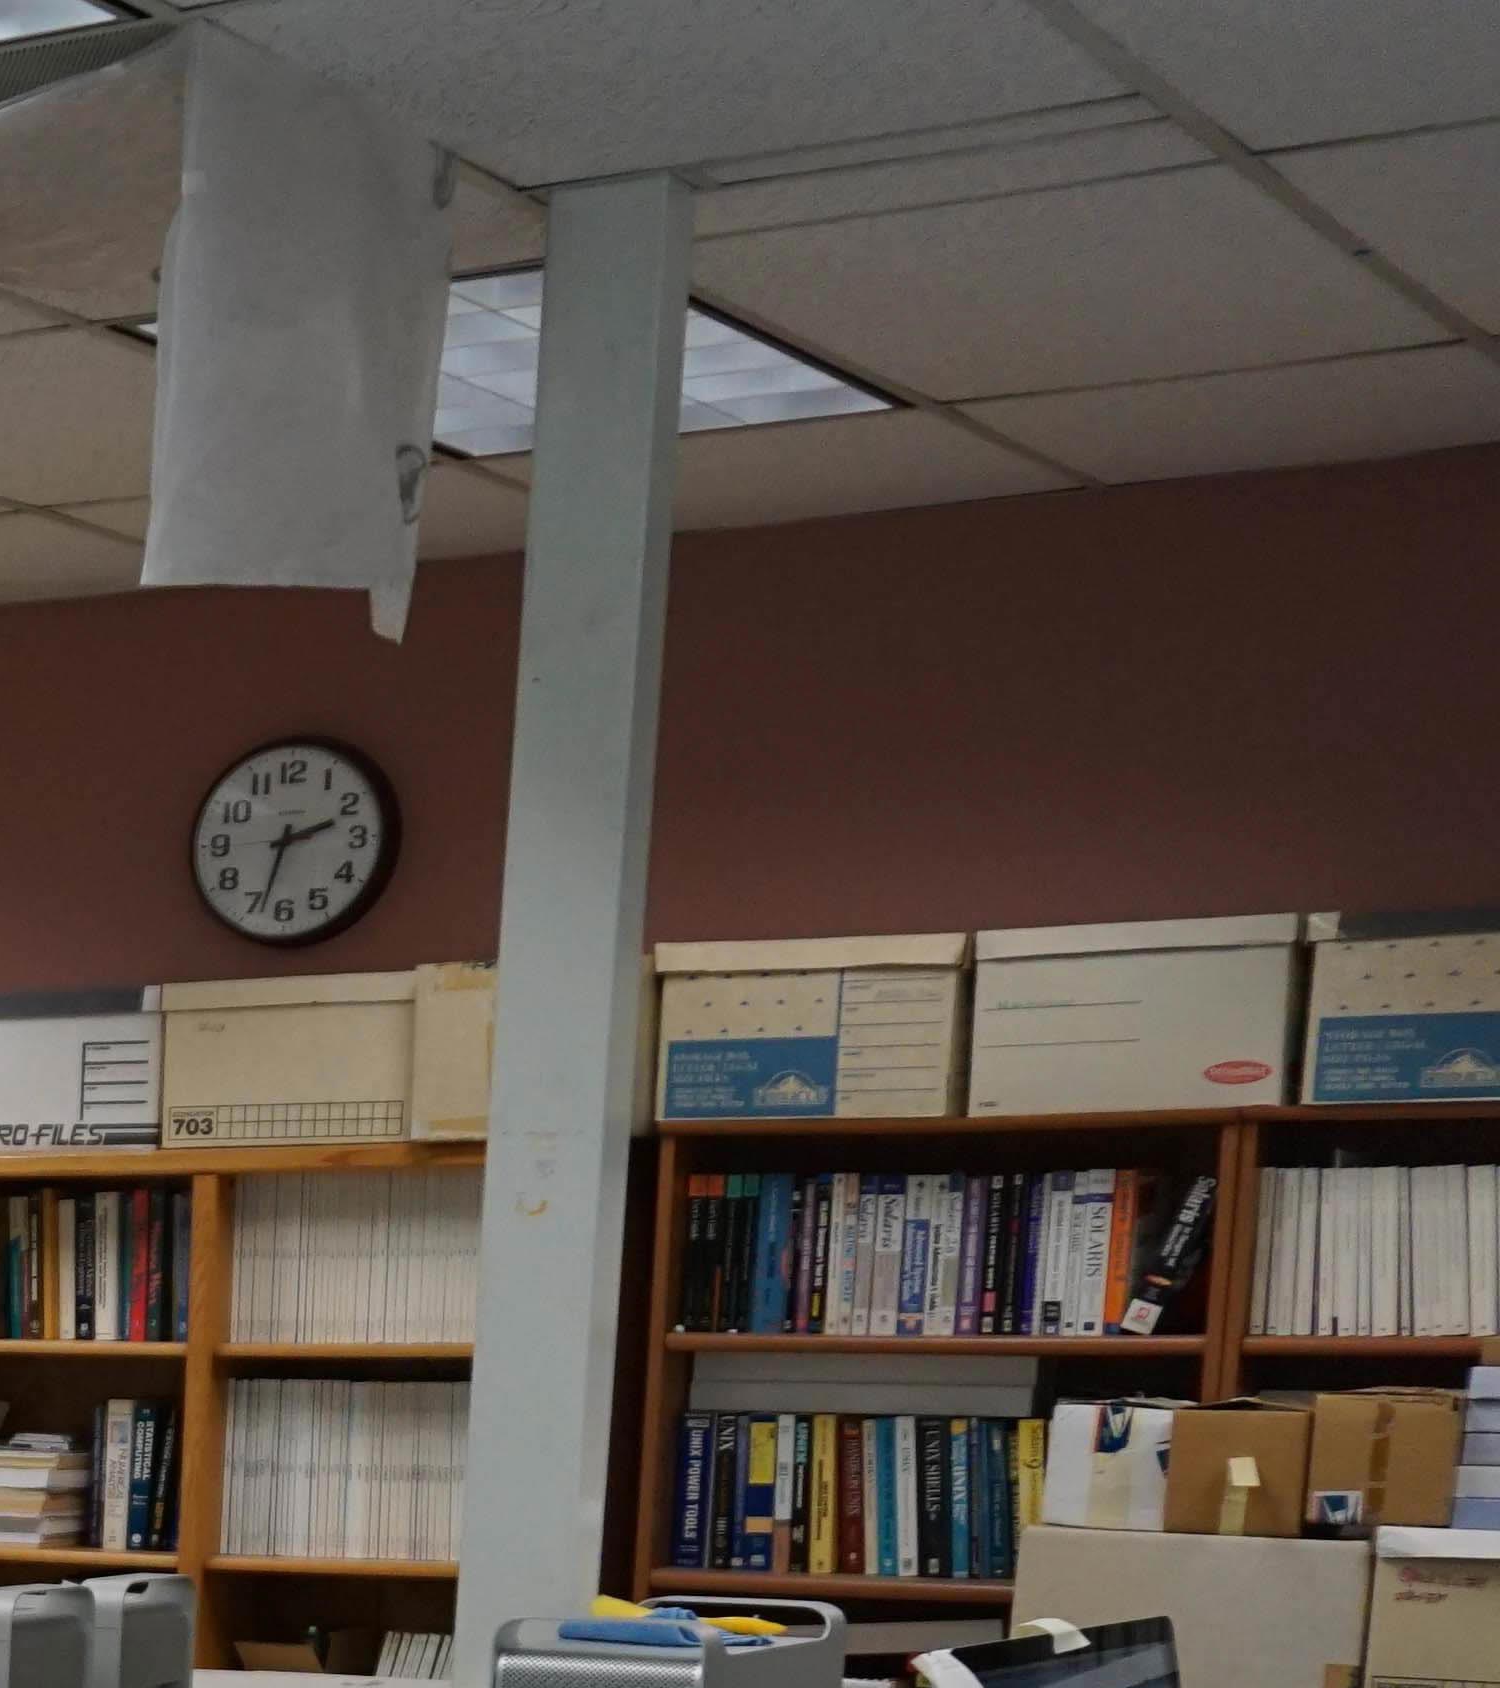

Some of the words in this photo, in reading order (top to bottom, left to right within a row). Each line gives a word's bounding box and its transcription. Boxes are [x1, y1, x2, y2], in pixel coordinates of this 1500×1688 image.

[252, 772, 271, 796] 11
[280, 759, 307, 785] 12
[323, 768, 332, 791] 1
[223, 800, 252, 824] 10
[340, 793, 360, 817] 2
[210, 834, 231, 858] 9
[348, 825, 368, 849] 3
[219, 866, 240, 891] 8
[334, 860, 356, 884] 4
[244, 891, 263, 914] 7
[273, 898, 295, 923] 6
[308, 888, 329, 911] 5
[173, 1118, 213, 1136] 703
[1177, 1176, 1218, 1224] Solaris
[881, 1196, 899, 1249] Solaris
[1084, 1206, 1108, 1278] SOLARIS
[690, 1429, 703, 1457] UNIX
[719, 1416, 736, 1451] UNIX
[926, 1430, 941, 1462] UNIX
[134, 1421, 144, 1479] COMPUTING
[143, 1421, 154, 1480] STATISTICAL
[1023, 1458, 1041, 1469] 9
[688, 1459, 702, 1501] POWER
[924, 1464, 940, 1512] SHELLS
[684, 1504, 699, 1539] TOOLS
